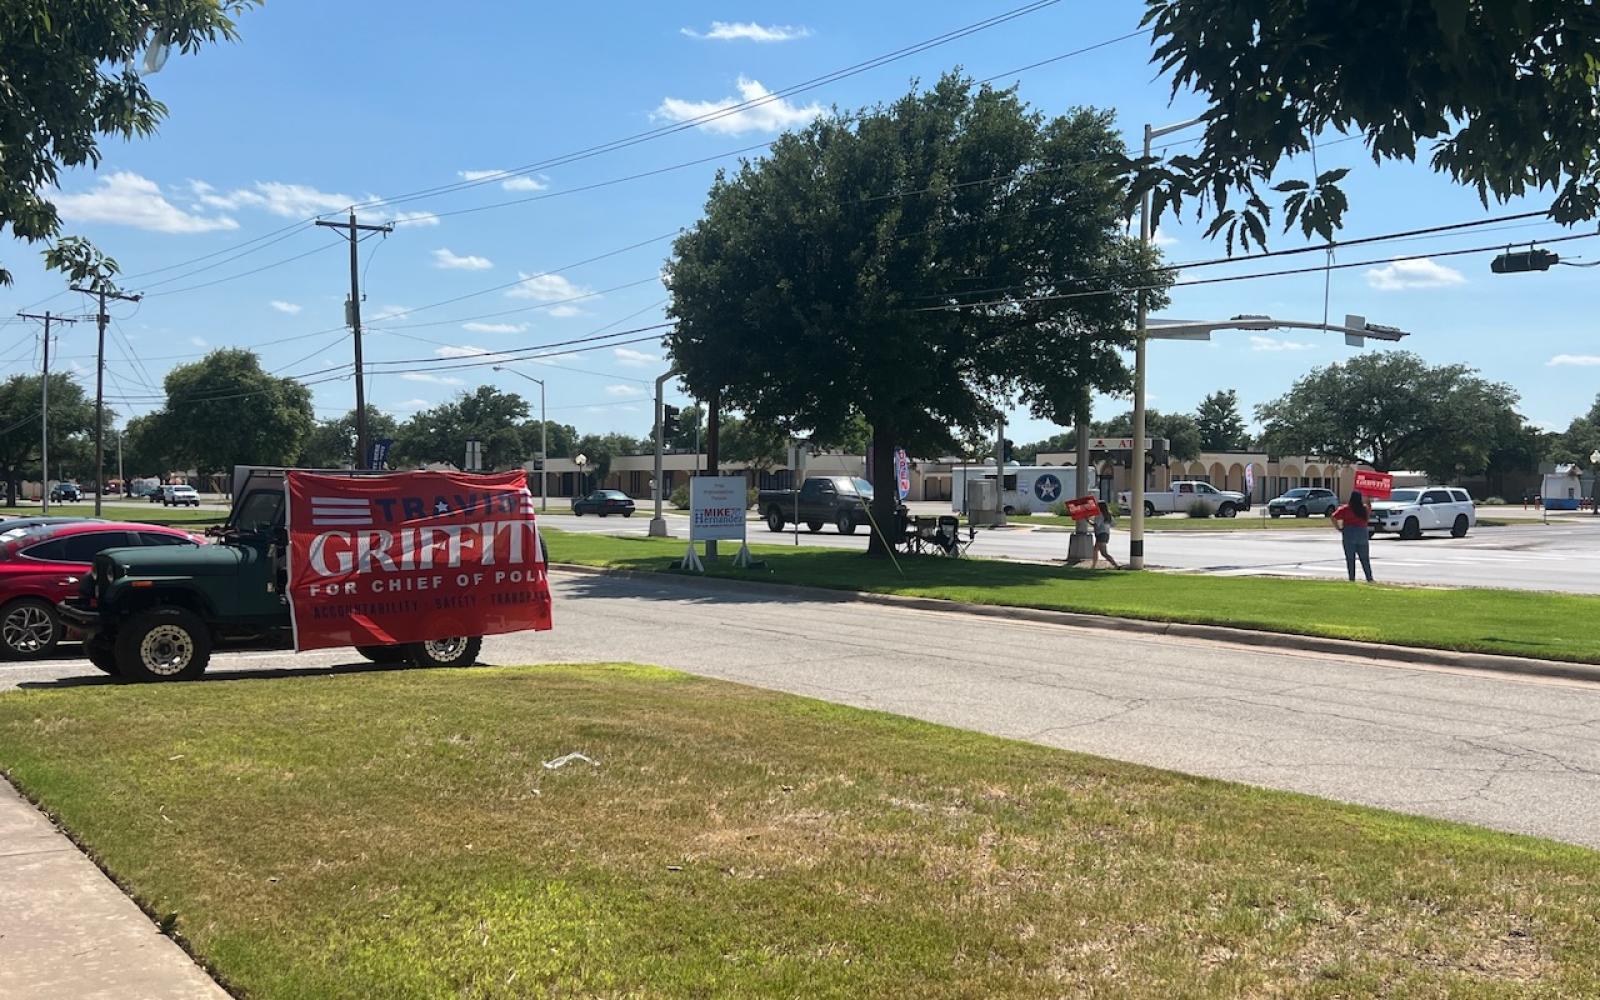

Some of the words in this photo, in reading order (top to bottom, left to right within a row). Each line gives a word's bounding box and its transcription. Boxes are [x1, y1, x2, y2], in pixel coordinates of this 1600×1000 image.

[899, 451, 909, 490] OPEN
[374, 493, 518, 522] TRAVIS
[704, 508, 730, 517] MIKE
[310, 582, 357, 596] FOR
[372, 576, 442, 593] CHIEF
[456, 574, 484, 587] OF
